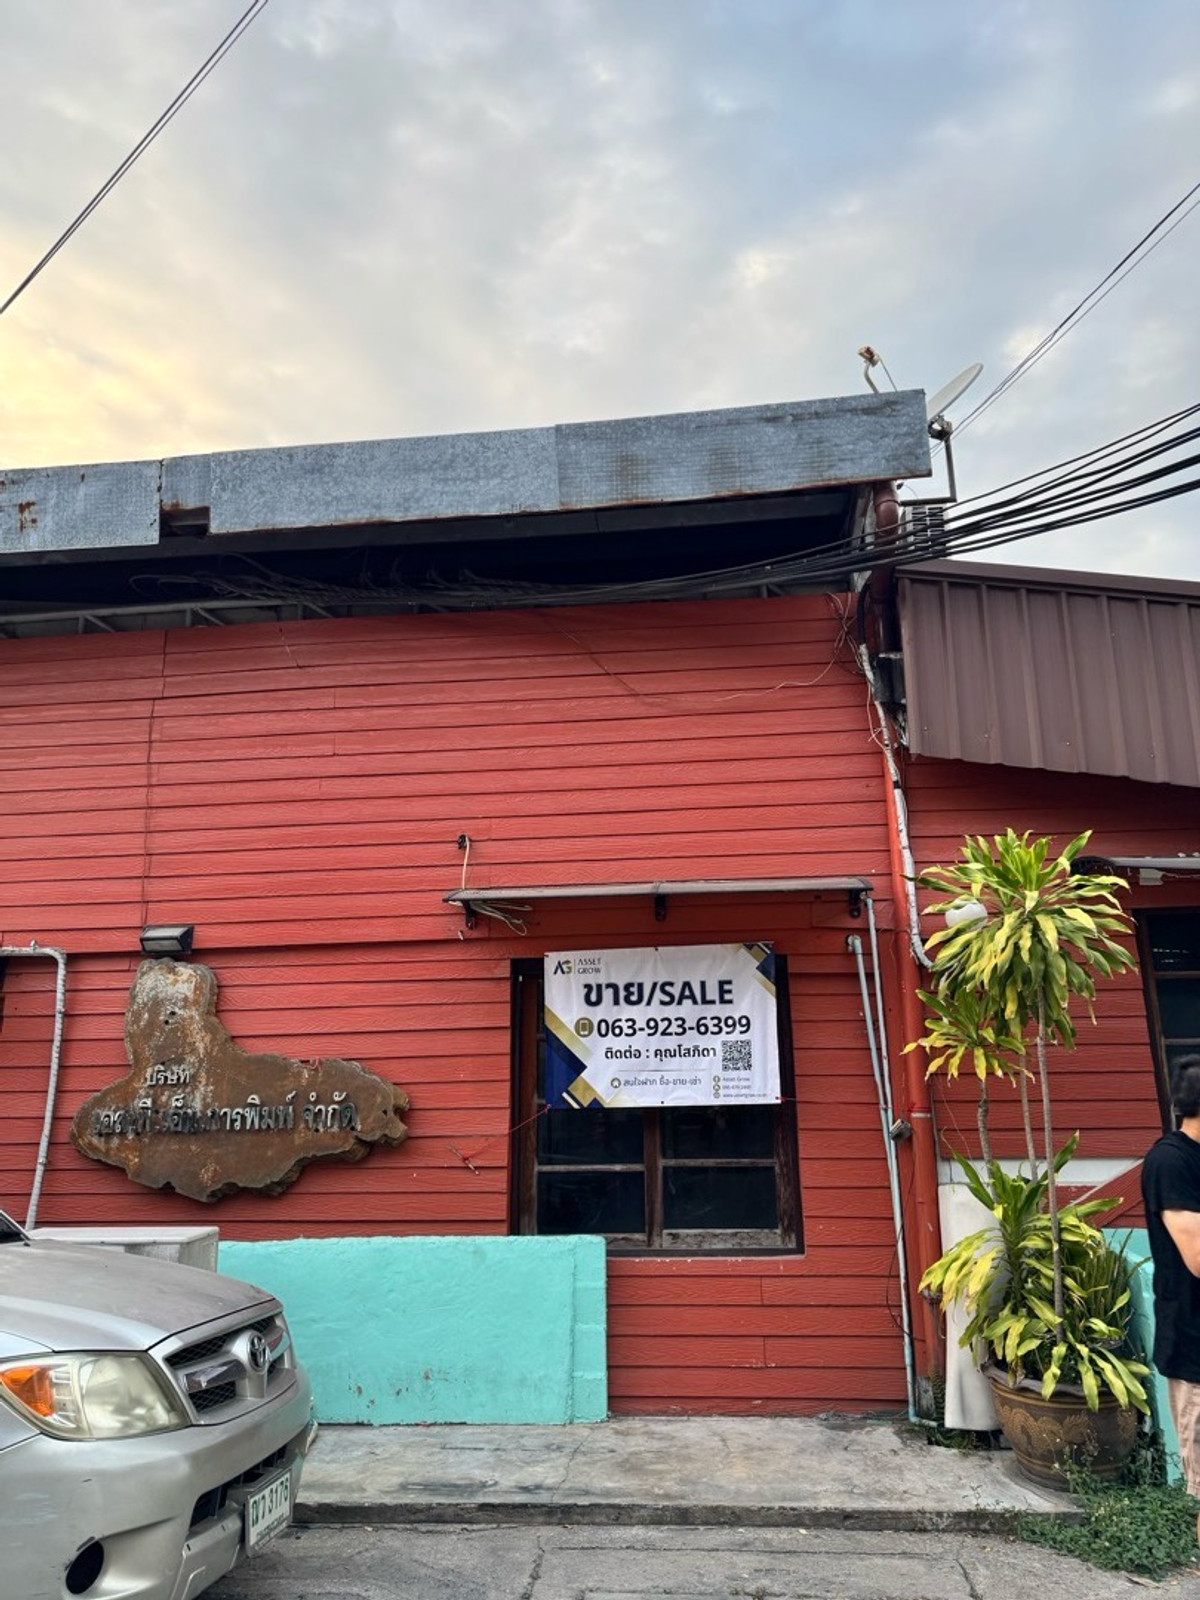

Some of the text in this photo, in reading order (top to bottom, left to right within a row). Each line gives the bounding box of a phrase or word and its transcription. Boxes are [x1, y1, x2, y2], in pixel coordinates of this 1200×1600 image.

[577, 967, 601, 975] GROW
[583, 980, 734, 1007] ขาย/SALE
[597, 1015, 751, 1038] 063-923-6399
[604, 1046, 642, 1060] ติดต่อ
[653, 1044, 717, 1062] คุณโสภิดา
[144, 1064, 190, 1087] บริษัท
[302, 1091, 358, 1131] จำกัด
[268, 1476, 288, 1514] 3176
